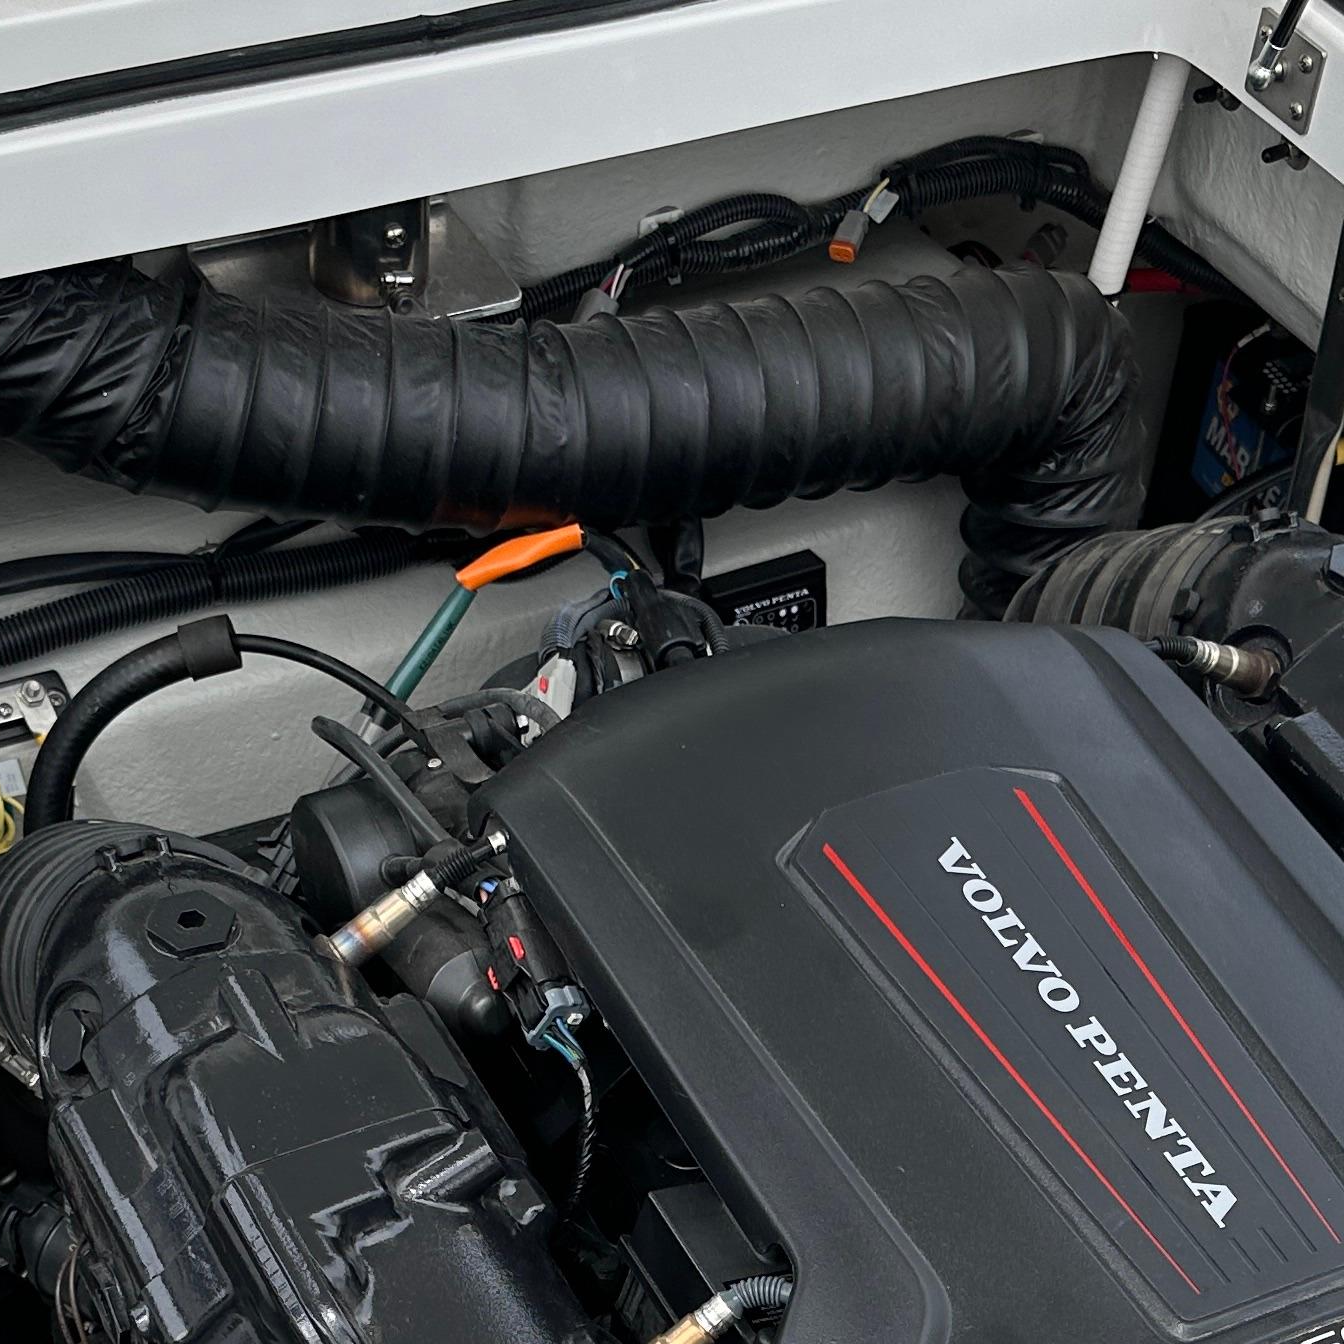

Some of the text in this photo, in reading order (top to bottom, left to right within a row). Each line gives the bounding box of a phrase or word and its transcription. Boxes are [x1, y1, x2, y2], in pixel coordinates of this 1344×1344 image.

[733, 598, 771, 616] VOLVO
[770, 586, 809, 604] PENTA
[937, 836, 1238, 1228] VOLVO PENTA
